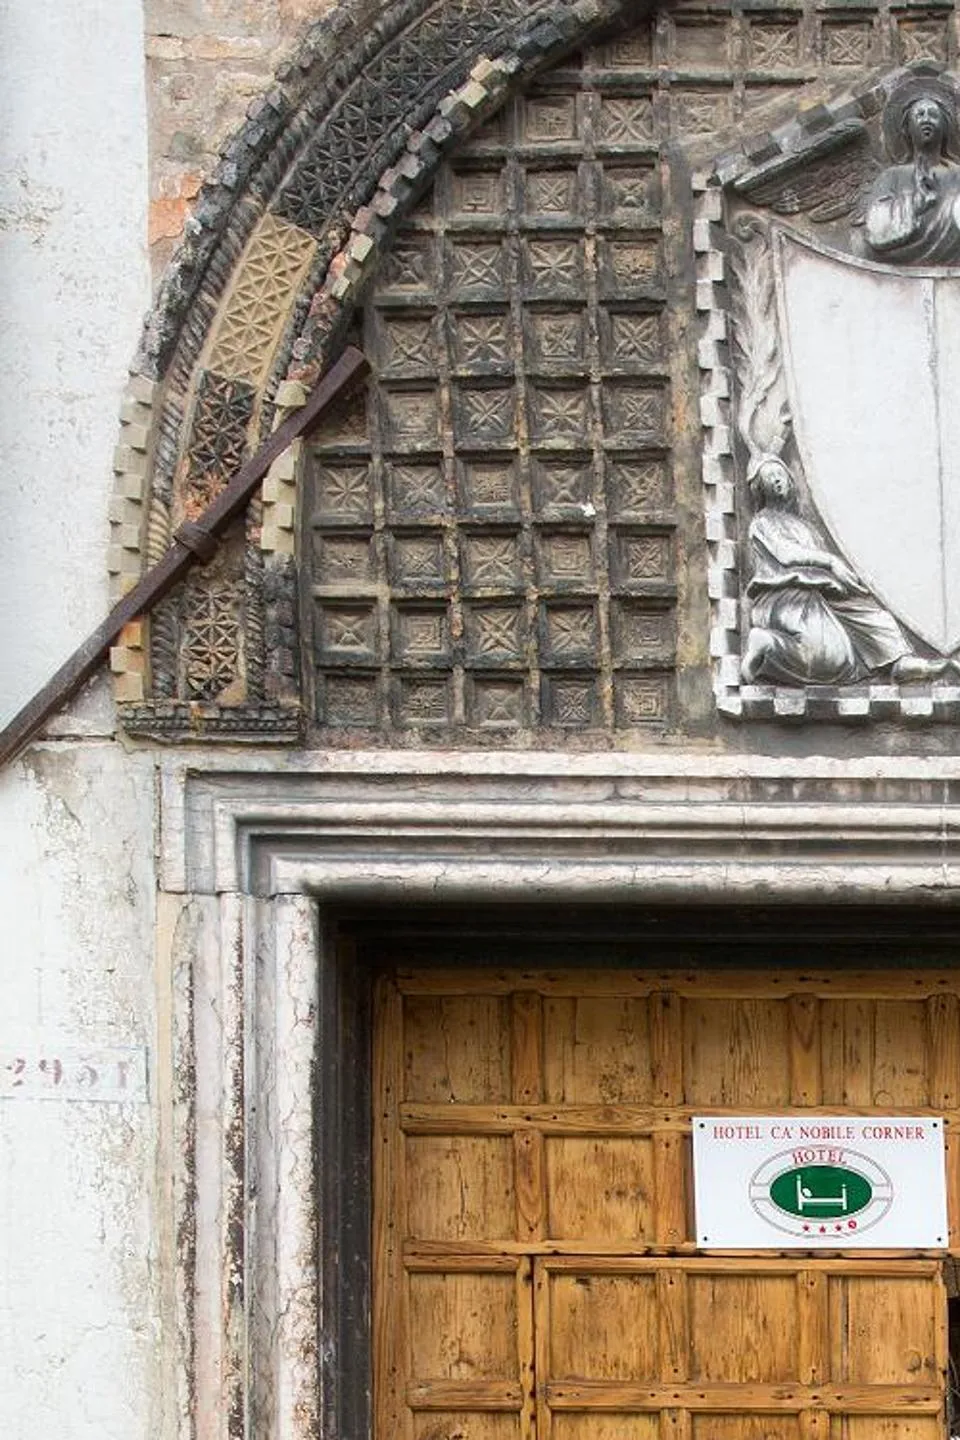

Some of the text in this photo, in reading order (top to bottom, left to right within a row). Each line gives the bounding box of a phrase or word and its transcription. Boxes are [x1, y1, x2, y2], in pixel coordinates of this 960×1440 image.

[713, 1125, 763, 1140] HOTEL
[799, 1125, 855, 1140] NOBILE
[861, 1125, 925, 1140] CORNER
[792, 1149, 848, 1165] HOTEL
